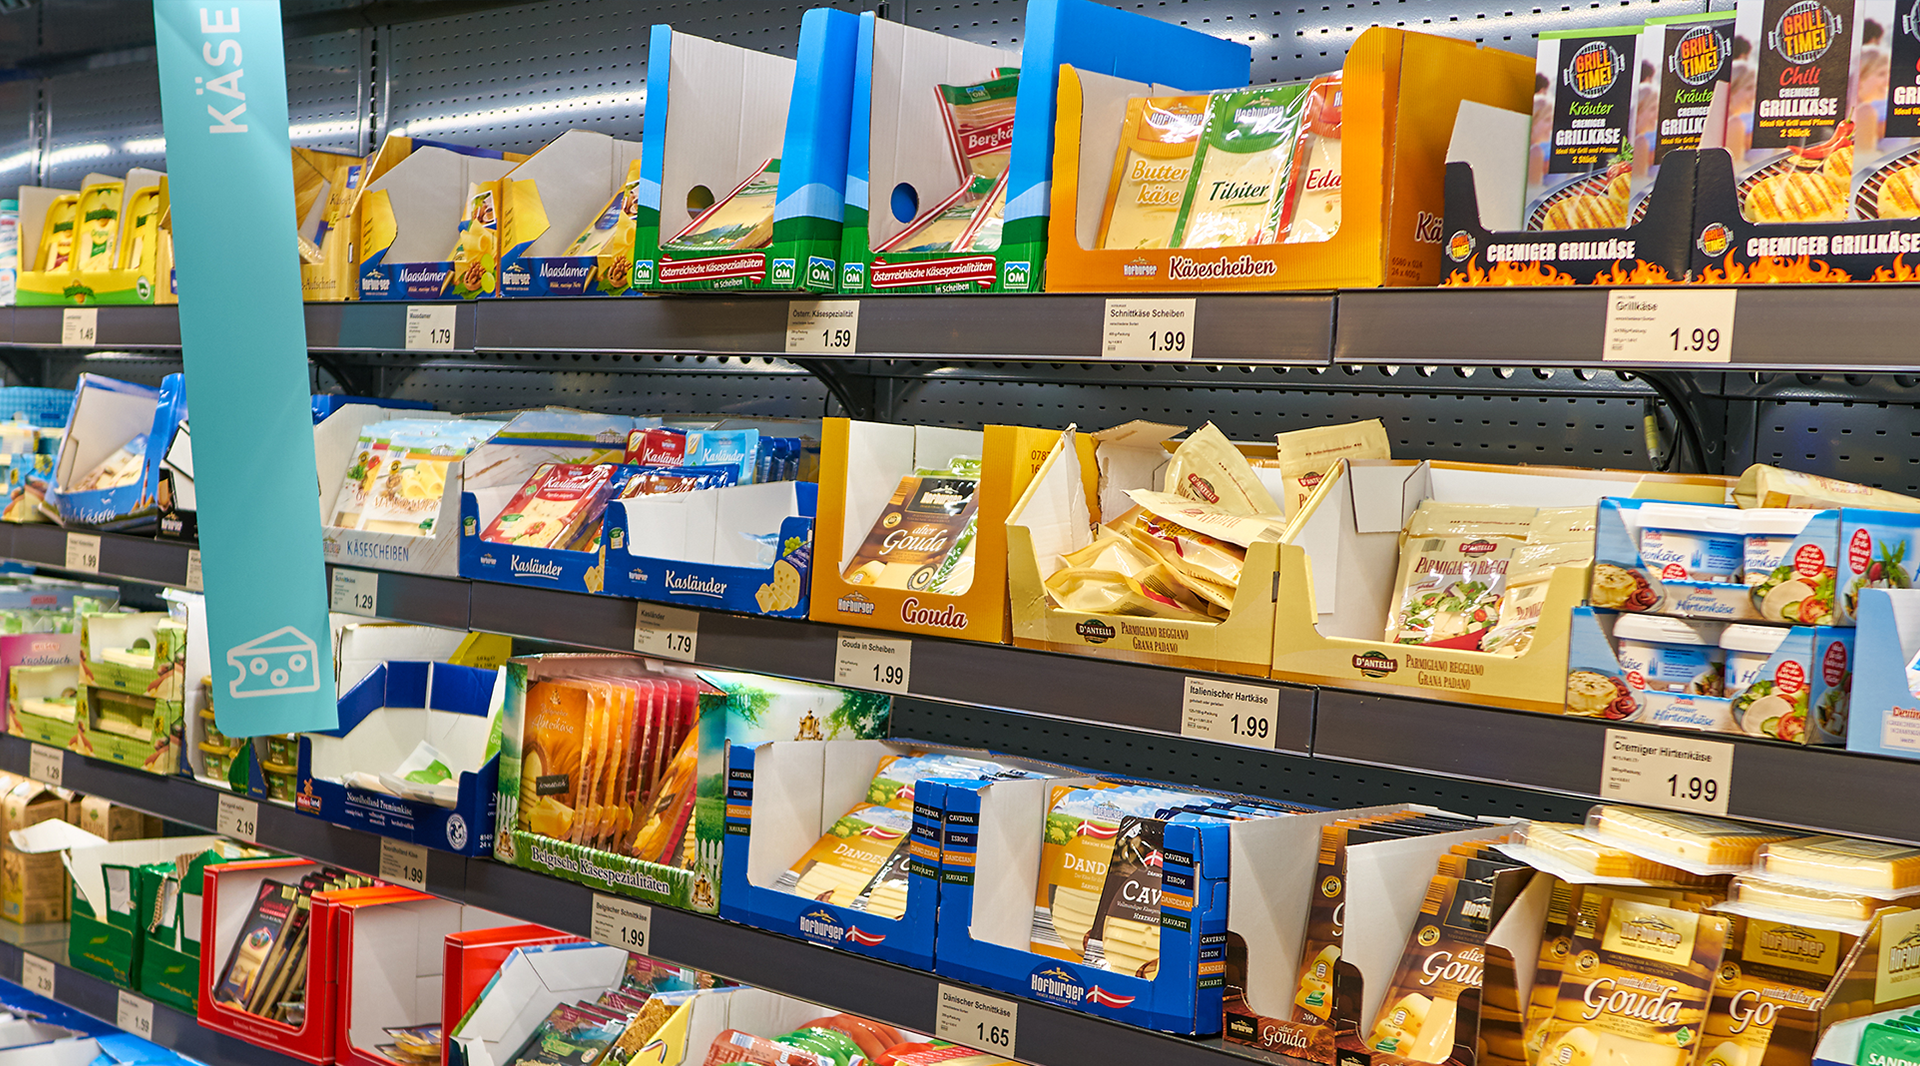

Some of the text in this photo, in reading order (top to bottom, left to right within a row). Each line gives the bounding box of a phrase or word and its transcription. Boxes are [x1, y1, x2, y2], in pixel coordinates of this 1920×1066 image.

[1783, 8, 1826, 36] GRILL
[1681, 32, 1717, 59] GRILL
[1784, 27, 1827, 57] TIME!
[1575, 47, 1611, 73] GRILL
[1681, 53, 1718, 78] TIME!
[194, 7, 248, 134] KÄSE
[1576, 68, 1612, 91] TIME!
[1779, 66, 1822, 86] Chili
[1778, 87, 1821, 98] CREMIGER
[1569, 101, 1614, 116] Kräuter
[1759, 97, 1838, 117] GRILLKÄSE
[1555, 128, 1621, 146] GRILLKÄSE
[1780, 129, 1787, 138] 2
[1572, 156, 1577, 164] 2
[1131, 160, 1190, 181] Butter
[1137, 184, 1180, 205] käse
[1209, 181, 1270, 201] Tilsiter
[1486, 238, 1636, 262] CREMIGER GRILLKÄSE
[1746, 231, 1920, 257] CREMIGER GRILLKÄSE
[398, 267, 447, 283] Maasdamer
[539, 263, 589, 277] Maasdamer
[637, 269, 650, 278] OM
[660, 258, 763, 277] Österreichische Käsespezialitäten
[775, 268, 790, 278] OM
[811, 270, 831, 281] OM
[873, 261, 993, 282] Österreichische Käsespezialitäten
[1008, 272, 1025, 283] OM
[1169, 255, 1276, 280] Käsescheiben
[719, 278, 743, 288] Scheiben
[846, 273, 860, 283] OM
[942, 283, 969, 293] Scheiben
[1110, 309, 1185, 318] Schnittkäse Scheiben
[1615, 301, 1658, 311] Grillkäse
[430, 328, 451, 344] 1.79
[822, 329, 851, 348] 1.59
[1149, 331, 1185, 351] 1.99
[1669, 327, 1720, 352] 1.99
[643, 448, 684, 466] Kaslände
[702, 448, 745, 462] Kasländer
[912, 524, 938, 535] alter
[346, 539, 409, 562] KÄSESCHEIBEN
[878, 529, 949, 556] Gouda
[510, 554, 563, 576] Kasländer
[665, 569, 727, 594] Kasländer
[354, 593, 373, 610] 1.29
[837, 598, 875, 615] Hofburger
[641, 609, 665, 621] Kasländer
[901, 596, 968, 630] Gouda
[1079, 625, 1112, 636] D'ANTELLI
[1121, 621, 1189, 641] PARMIGIANO REGGIANO
[666, 632, 692, 653] 1.79
[842, 639, 895, 654] Gouda in Scheiben
[1132, 636, 1178, 653] GRANA PADANO
[1356, 656, 1394, 670] D'ANTELLI
[1405, 653, 1485, 677] PARMIGIANO REGGIANO
[873, 664, 904, 685] 1.99
[1417, 670, 1472, 690] GRANA PADANO
[1190, 685, 1269, 705] Italienischer Hartkäse
[1230, 713, 1269, 739] 1.99
[1613, 741, 1713, 763] Cremiger Hirtenkäse
[1668, 774, 1718, 803] 1.99
[236, 818, 254, 835] 2.19
[833, 843, 888, 866] DANDES
[1063, 852, 1107, 876] DAND
[1164, 852, 1190, 865] CAVERNA
[403, 866, 423, 883] 1.99
[531, 845, 671, 896] Belgische Käsespezialitäten
[1166, 875, 1186, 886] ESROM
[1122, 880, 1162, 906] CAV
[1161, 894, 1191, 909] DANDESAN
[595, 901, 648, 922] Belgischer Schnittkäse
[800, 915, 844, 940] Hofburger
[1162, 916, 1188, 929] HAVARTI
[620, 926, 645, 947] 1.99
[1619, 921, 1682, 949] Hofburger
[1759, 930, 1826, 959] Hofburger
[1031, 973, 1084, 1001] Hofburger
[943, 992, 1011, 1017] Dänischer Schnittkäse
[1581, 977, 1684, 1025] Gouda
[977, 1022, 1009, 1047] 1.65
[1263, 1025, 1307, 1049] Gouda
